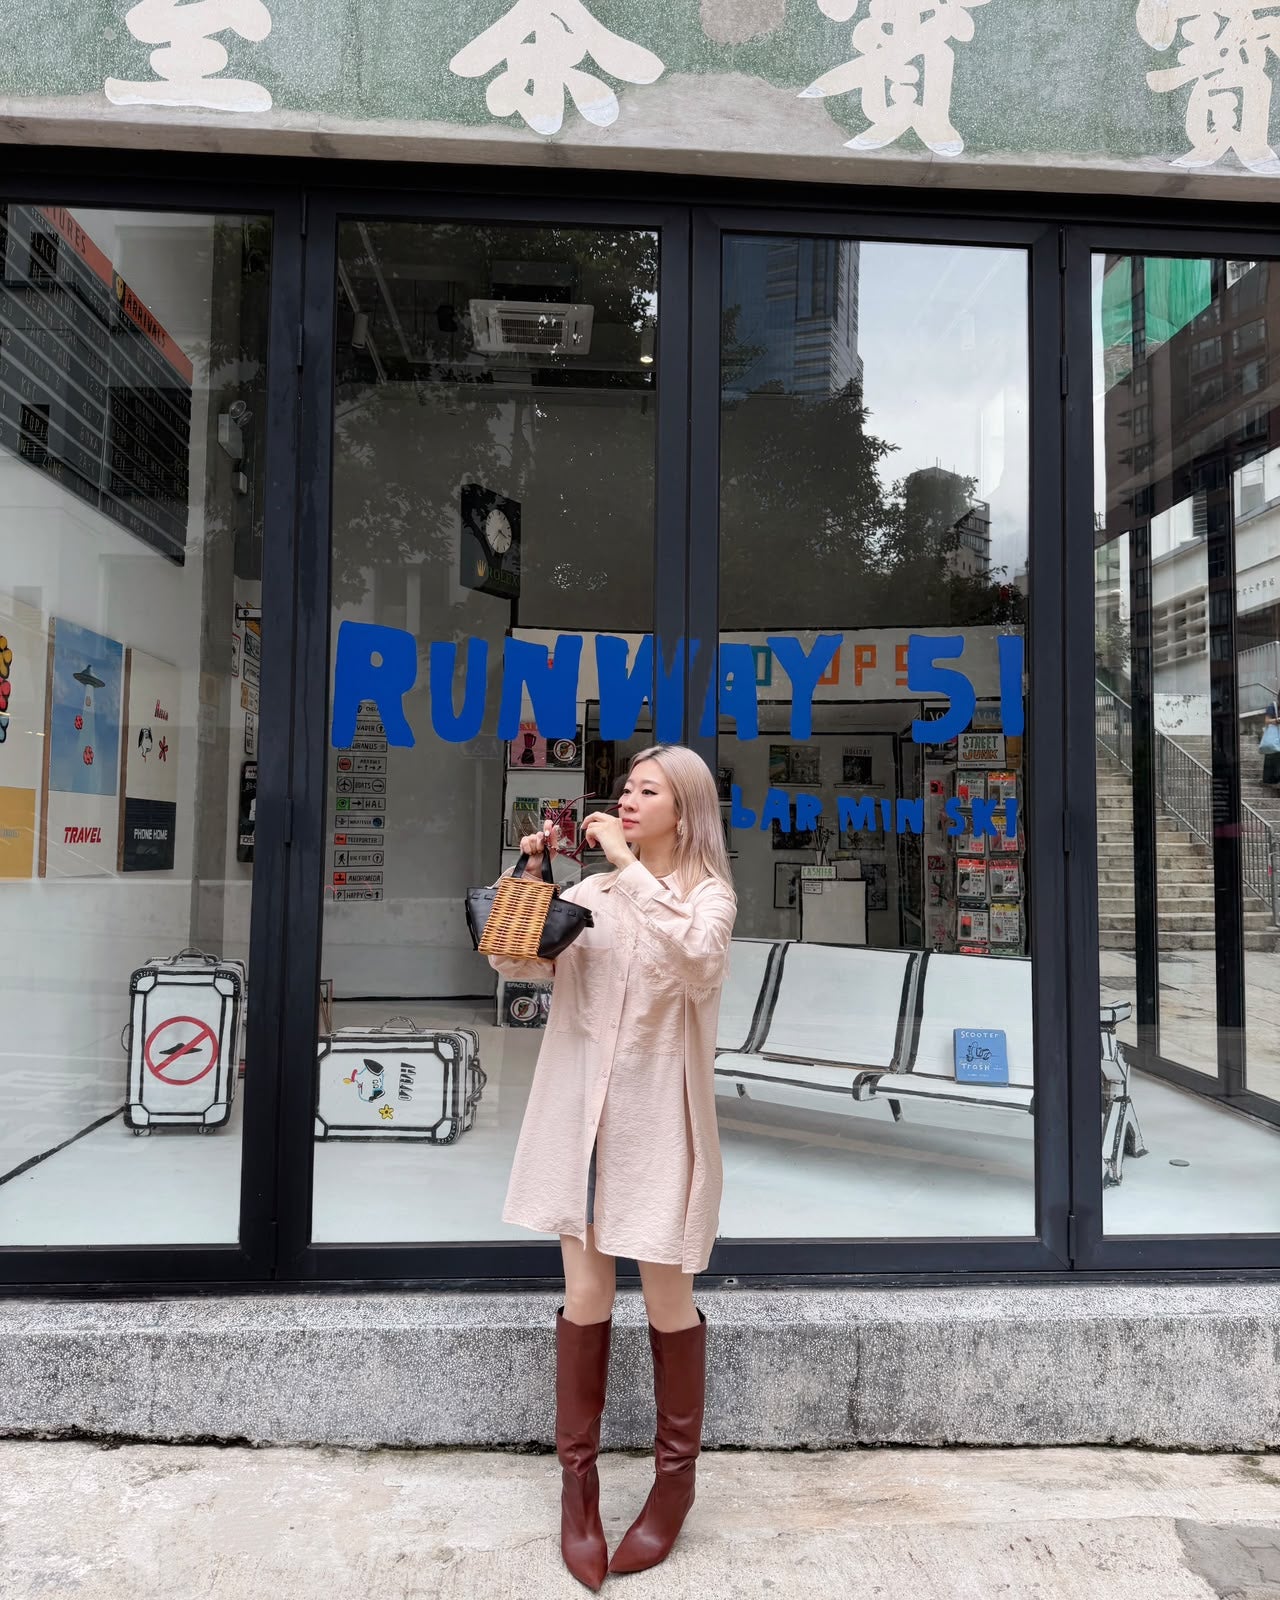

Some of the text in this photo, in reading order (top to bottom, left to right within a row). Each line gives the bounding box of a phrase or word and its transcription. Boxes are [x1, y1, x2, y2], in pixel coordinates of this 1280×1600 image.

[125, 294, 166, 349] ARRIVALS
[331, 620, 843, 748] RUNWAY
[907, 633, 1023, 743] 51
[963, 735, 999, 749] STREET
[963, 750, 999, 760] JUNK
[365, 801, 382, 809] HAL
[64, 826, 102, 844] TRAVEL
[133, 828, 168, 841] PHONE HOME
[802, 866, 833, 878] CASHIER
[346, 892, 364, 900] HAPPY
